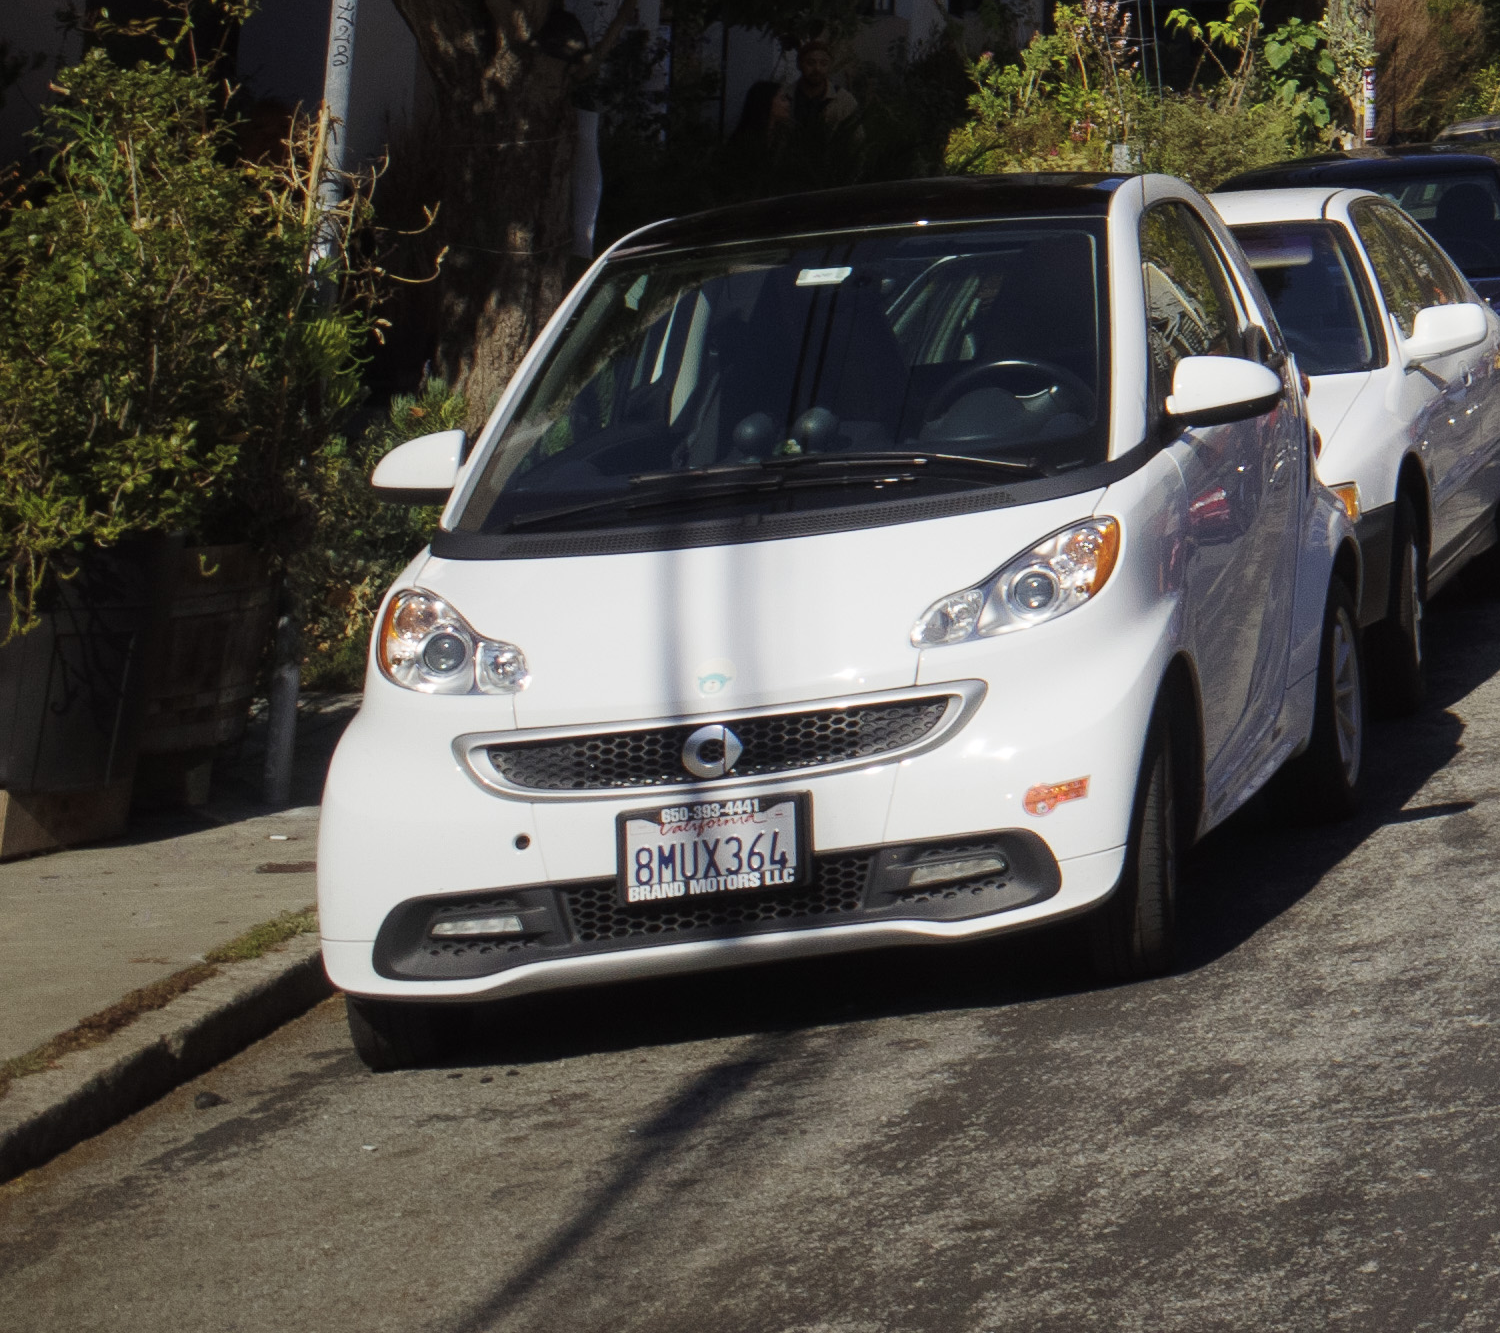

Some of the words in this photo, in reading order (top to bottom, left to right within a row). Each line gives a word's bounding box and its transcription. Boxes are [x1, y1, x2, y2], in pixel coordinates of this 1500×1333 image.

[659, 813, 767, 836] California
[660, 798, 760, 823] 650-393-4441
[635, 828, 789, 886] 8MUX364
[628, 880, 685, 903] BRAND
[689, 872, 761, 895] MOTORS
[764, 868, 795, 884] LLC
